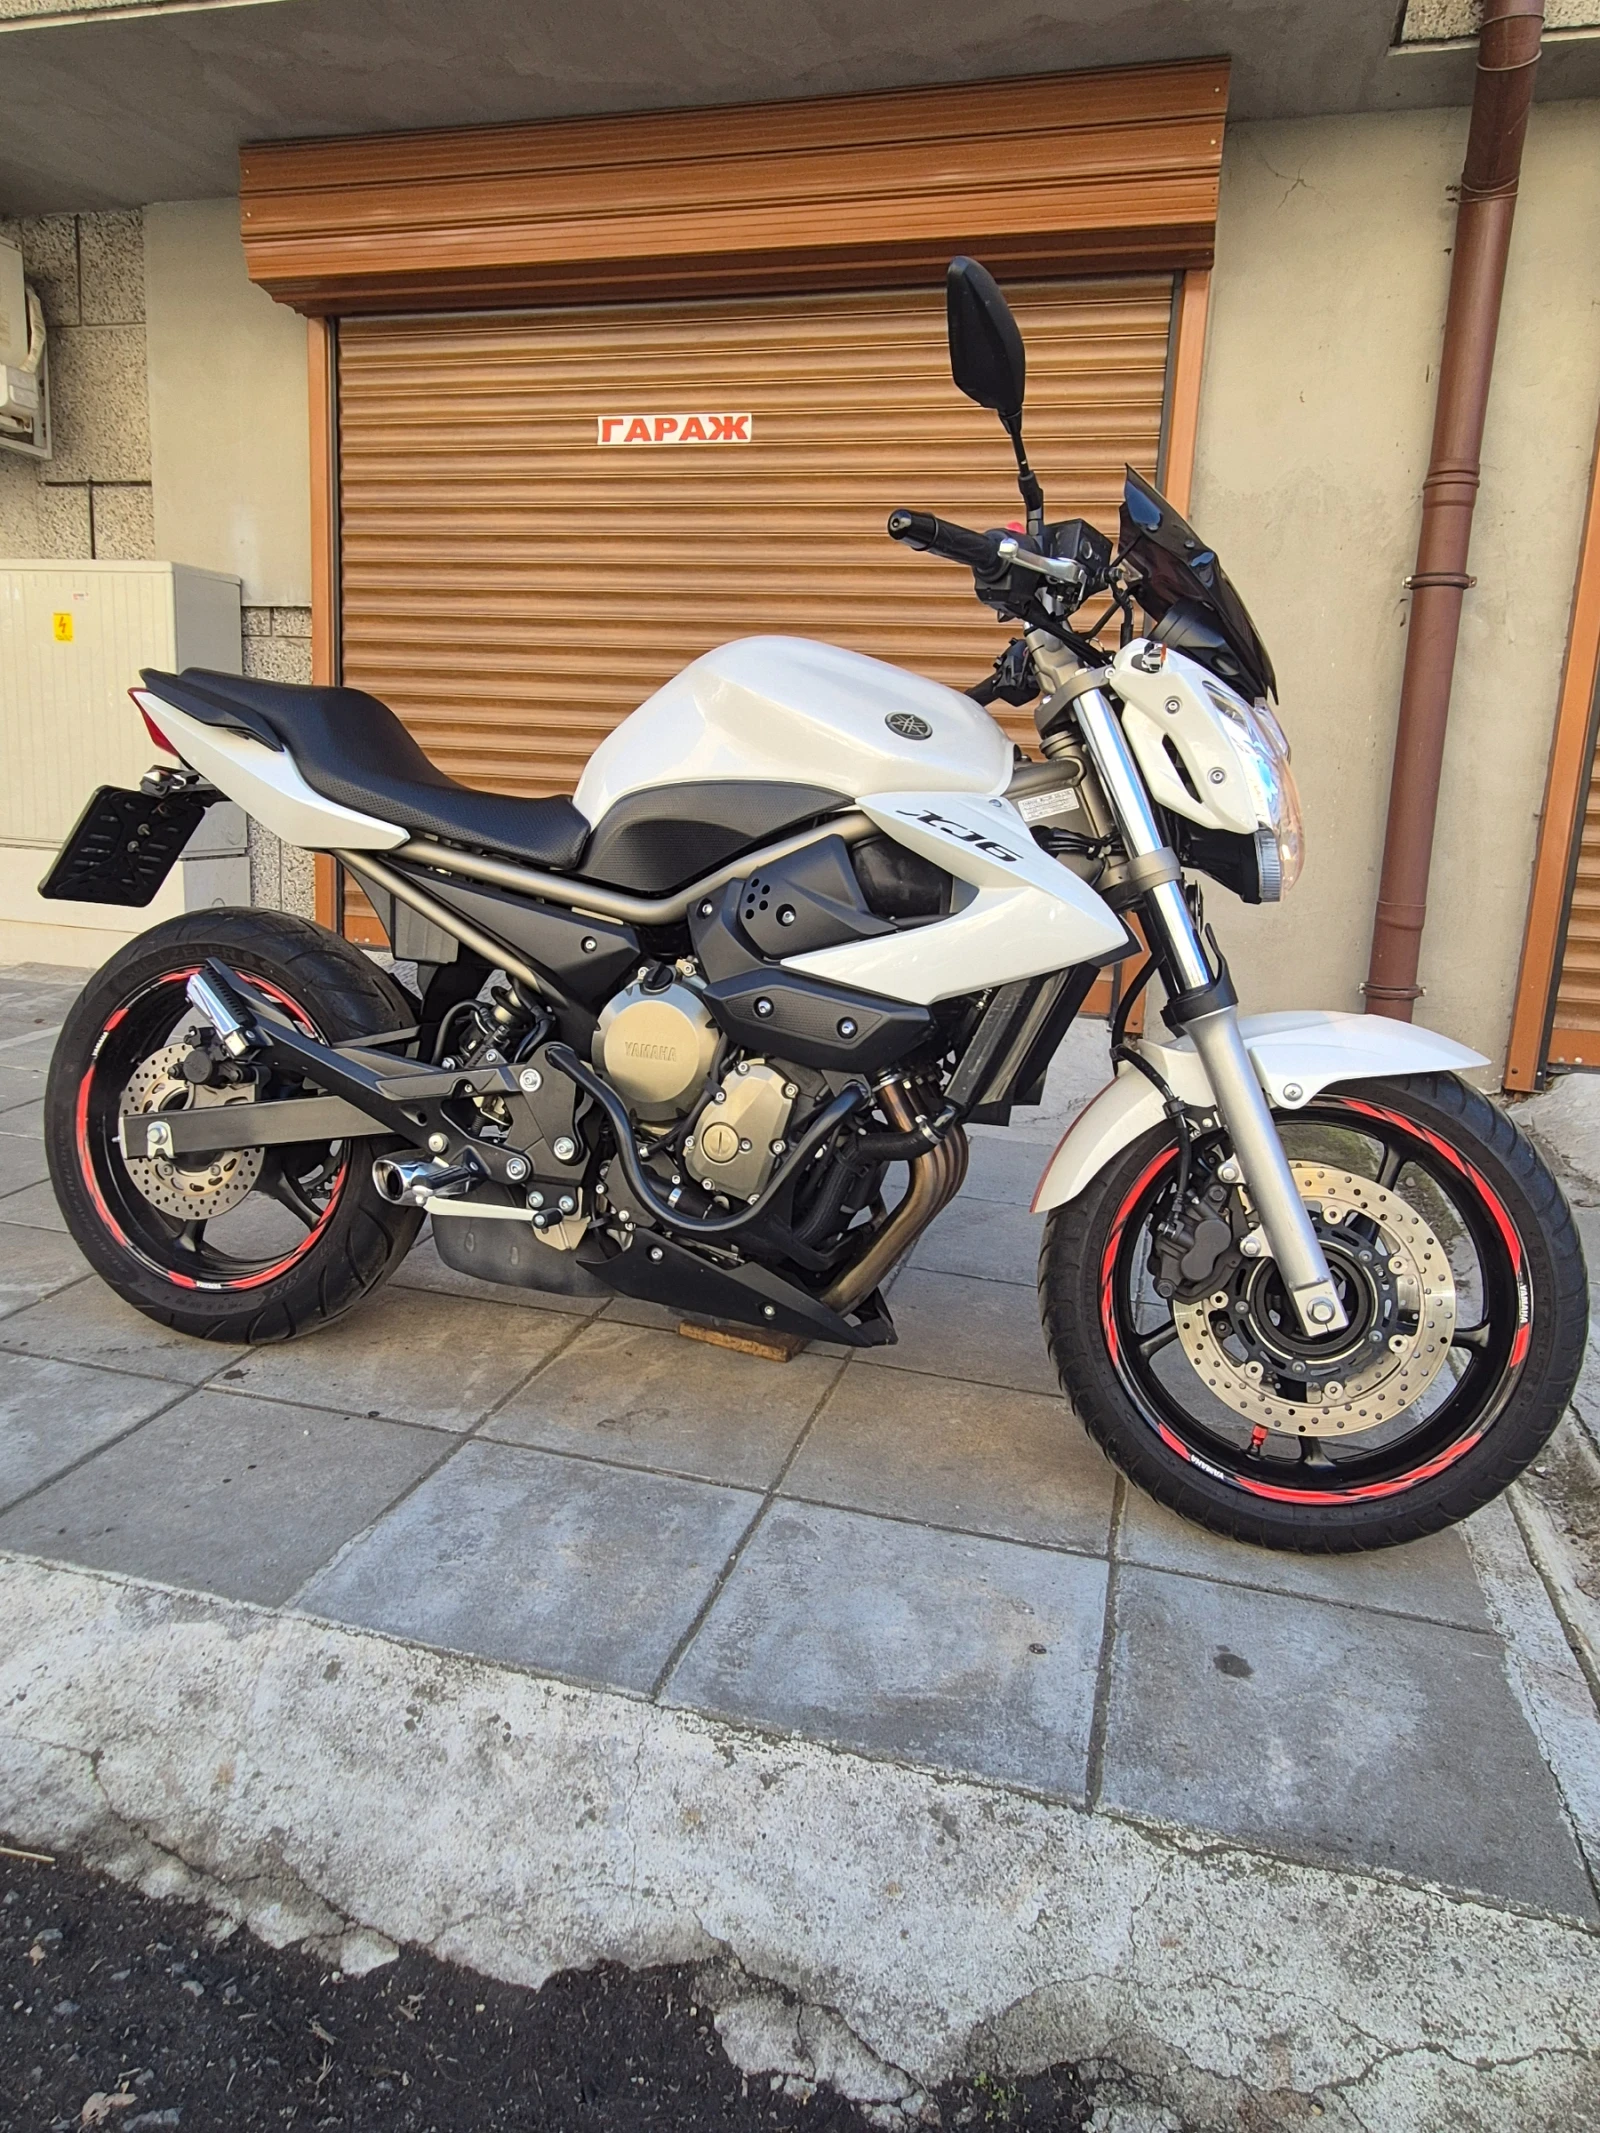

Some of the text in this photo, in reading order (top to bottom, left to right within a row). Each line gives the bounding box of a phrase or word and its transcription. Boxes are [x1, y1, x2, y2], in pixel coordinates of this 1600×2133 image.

[602, 416, 749, 442] ГАРАЖ
[895, 809, 1024, 862] XJ6
[624, 1041, 677, 1062] YAMAHA
[1519, 1284, 1529, 1324] YAMAHA
[1190, 1454, 1225, 1480] YAMAHA
